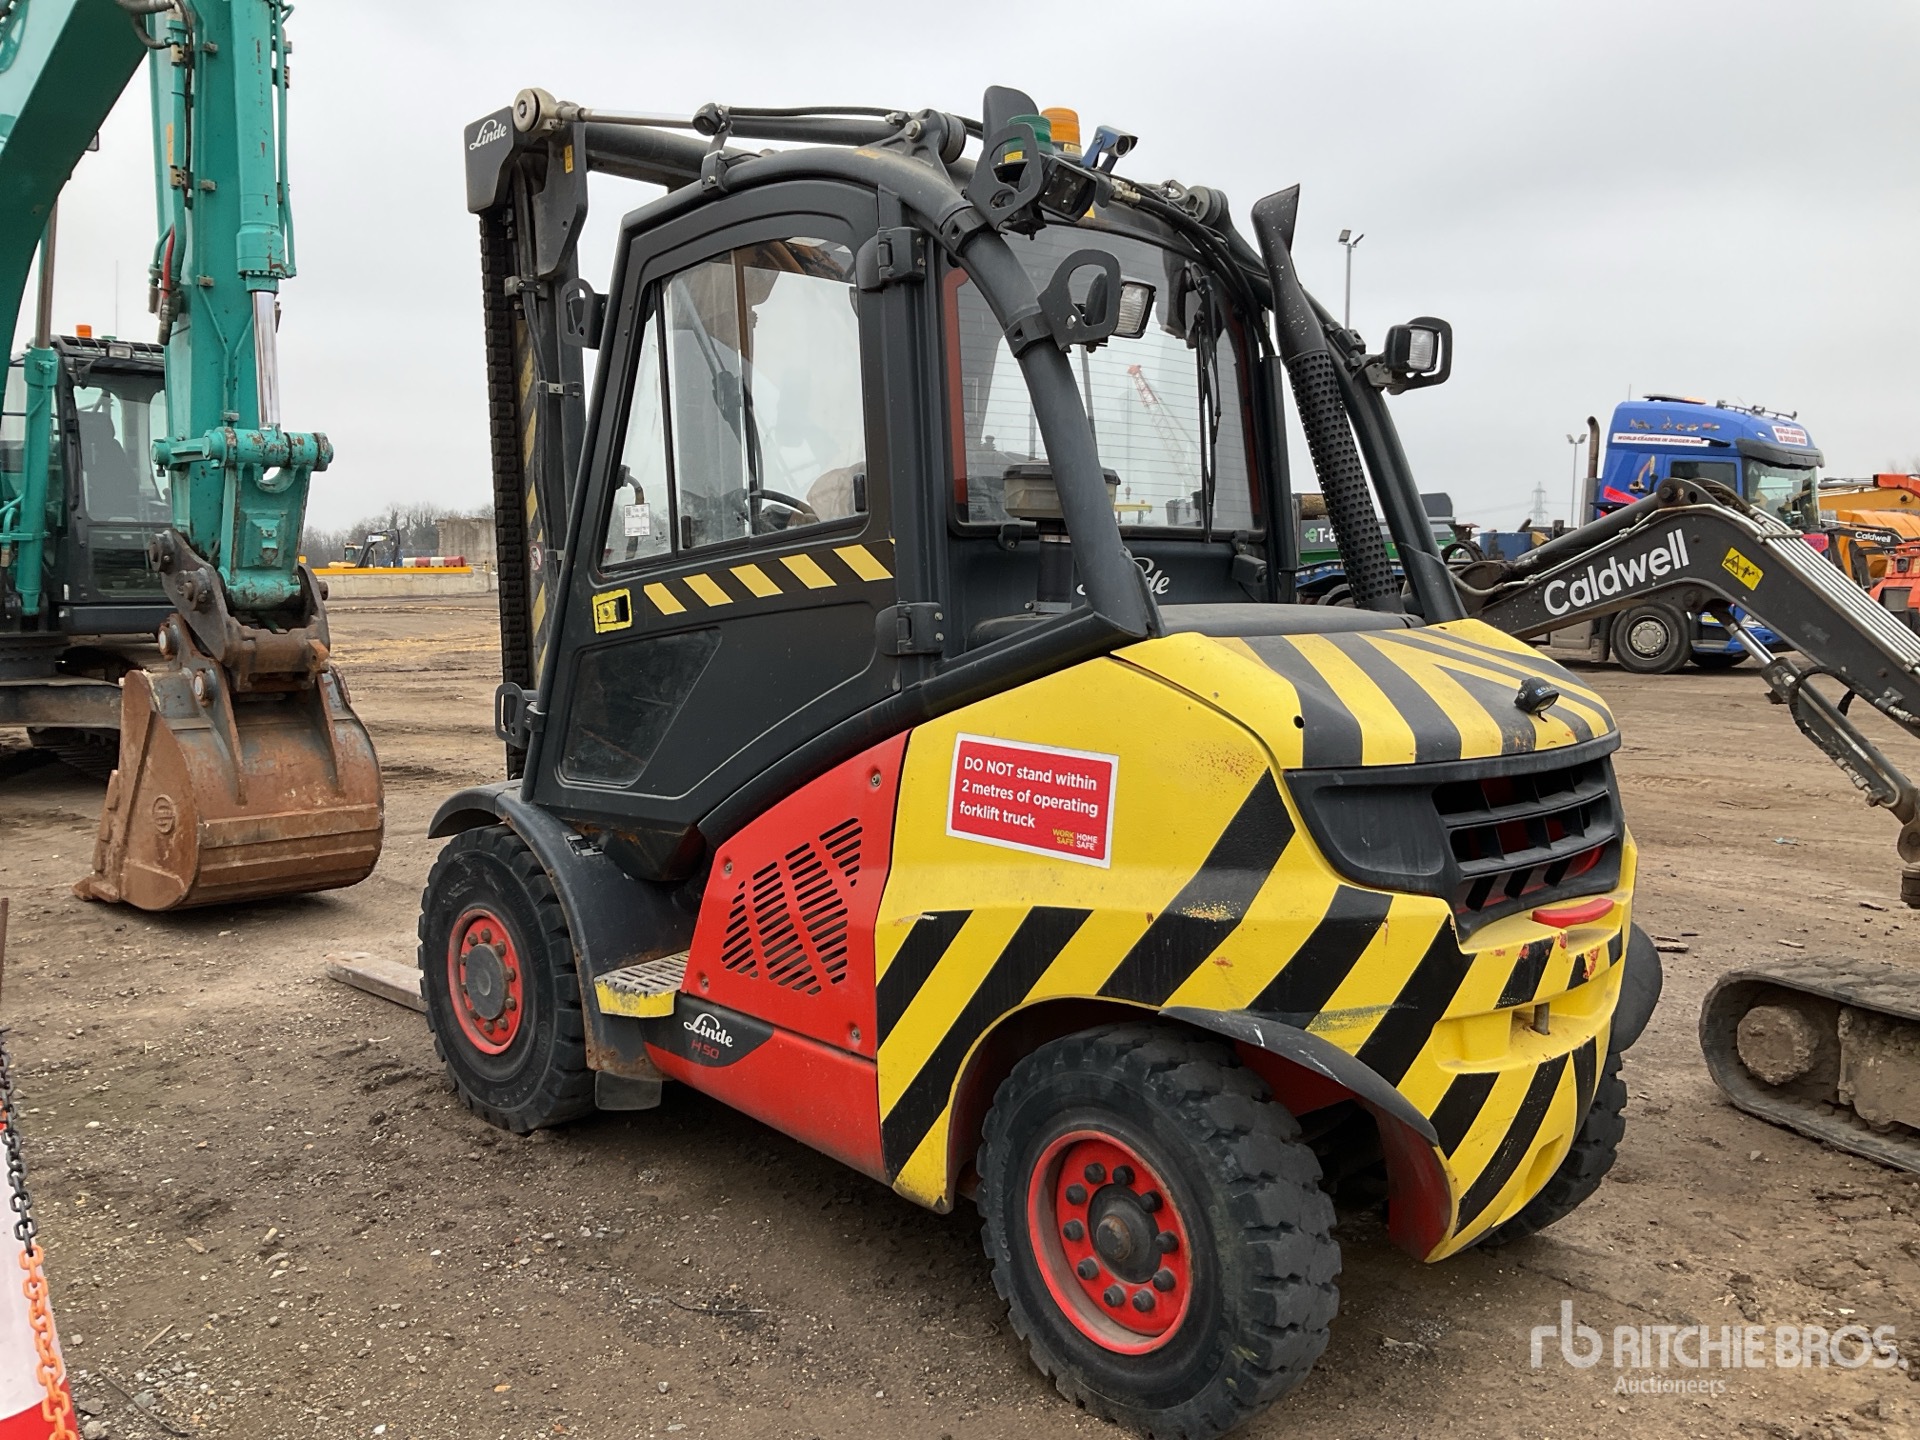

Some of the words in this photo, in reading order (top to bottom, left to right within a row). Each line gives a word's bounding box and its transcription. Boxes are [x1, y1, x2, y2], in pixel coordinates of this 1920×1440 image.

[469, 119, 507, 151] Linde
[1855, 531, 1892, 543] Caldwell
[1544, 528, 1690, 616] Caldwell
[964, 756, 983, 772] DO
[986, 760, 1014, 777] NOT
[1016, 766, 1052, 784] stand
[1055, 773, 1097, 791] within
[961, 779, 970, 793] 2
[972, 783, 1014, 801] metres
[1016, 789, 1031, 804] of
[1033, 794, 1099, 818] operating
[959, 801, 1000, 821] forklift
[1002, 809, 1036, 829] truck
[1052, 828, 1075, 839] WORK
[1076, 833, 1098, 844] HOME
[1056, 836, 1075, 847] SAFE
[1076, 840, 1095, 851] SAFE
[683, 1013, 733, 1048] Linde
